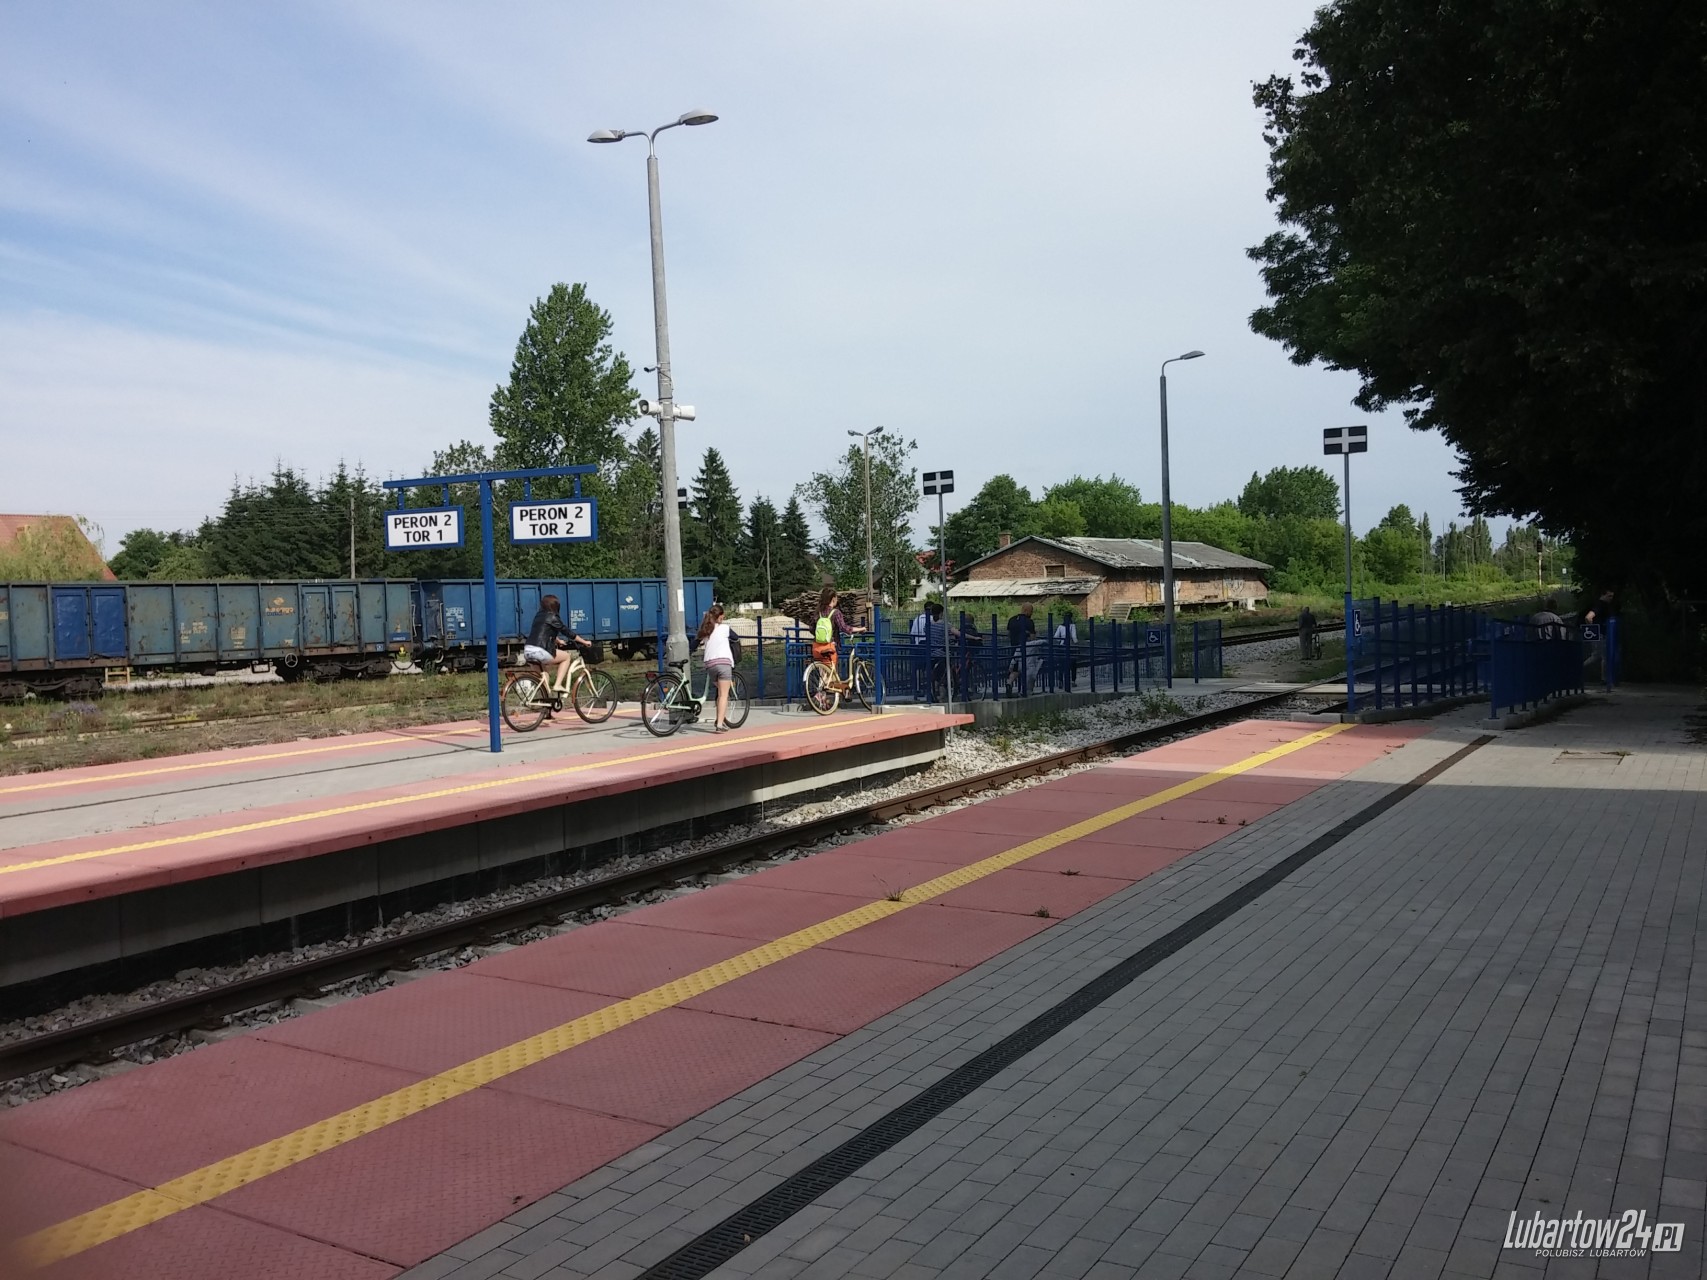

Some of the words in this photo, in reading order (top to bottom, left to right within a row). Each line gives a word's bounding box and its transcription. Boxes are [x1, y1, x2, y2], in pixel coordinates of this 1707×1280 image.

[519, 506, 568, 521] PERON
[574, 506, 584, 519] 2
[394, 515, 438, 529] PERON
[443, 514, 452, 526] 2
[404, 530, 431, 543] TOR
[437, 529, 443, 541] 1
[529, 523, 559, 536] TOR
[565, 522, 574, 535] 2
